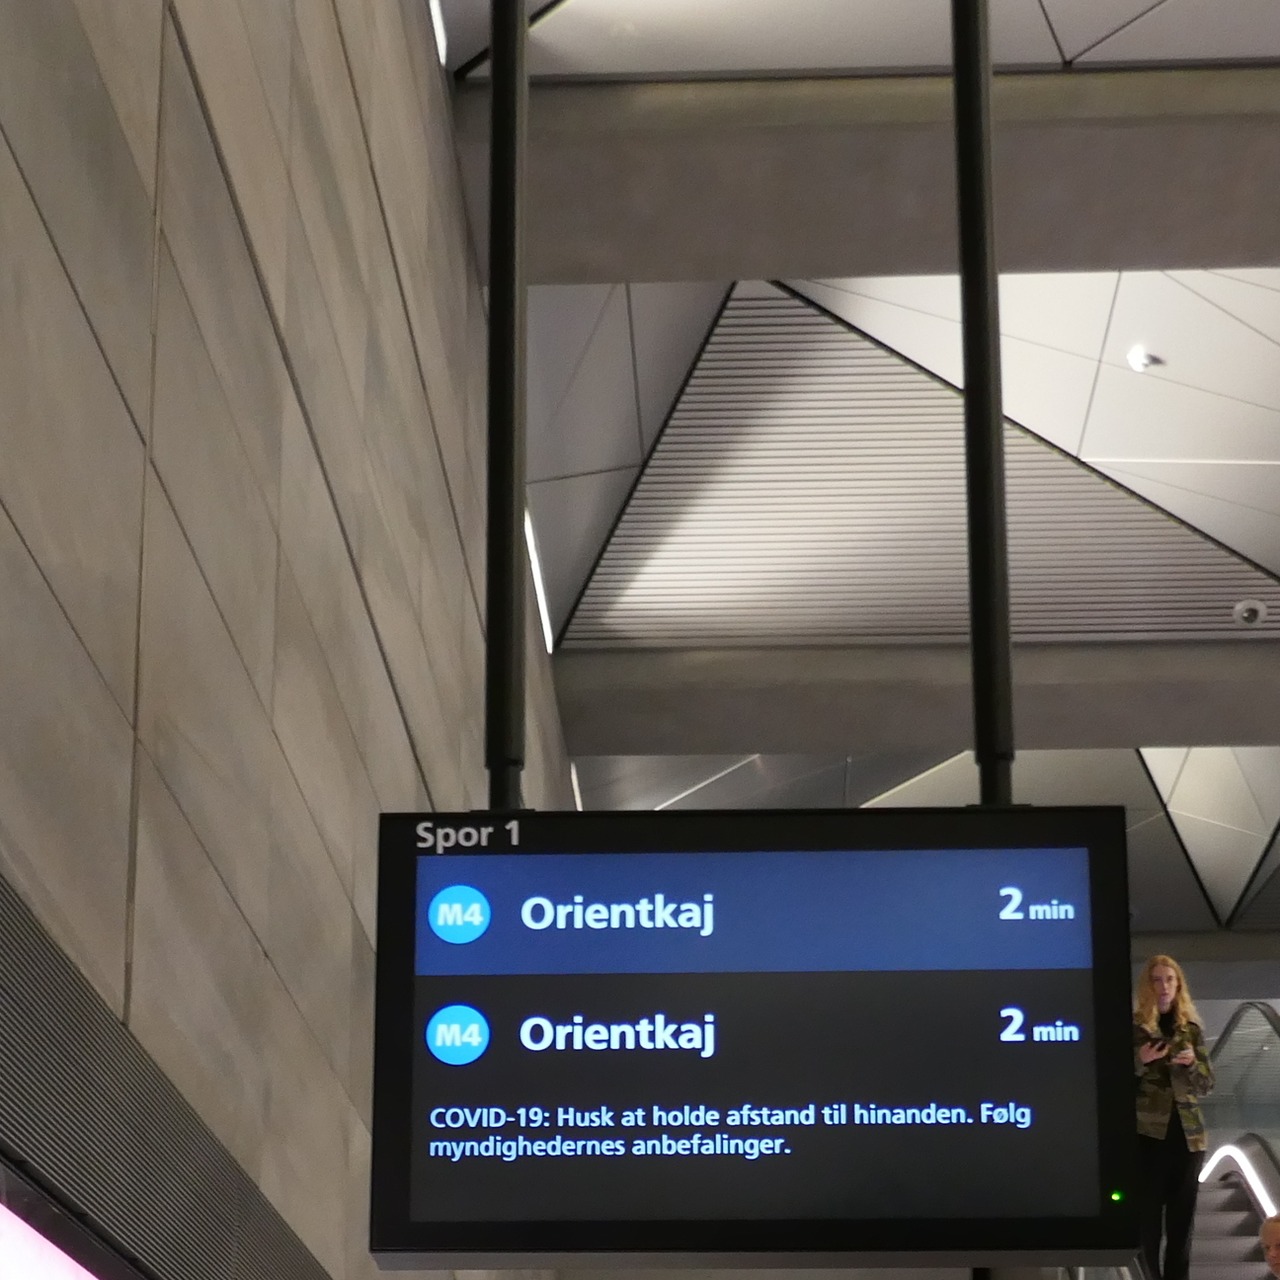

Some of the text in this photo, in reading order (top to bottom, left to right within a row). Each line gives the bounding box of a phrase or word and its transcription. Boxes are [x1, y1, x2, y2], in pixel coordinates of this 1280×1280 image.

[415, 821, 521, 853] Spor 1
[434, 886, 1075, 937] M4 Orientkaj 2 min
[433, 1007, 1080, 1058] M4 Orientkaj 2 min
[429, 1101, 1032, 1130] COVID-19: Husk at holde afstand til hinanden. Følg
[428, 1133, 792, 1162] myndighedernes anbefalinger.
